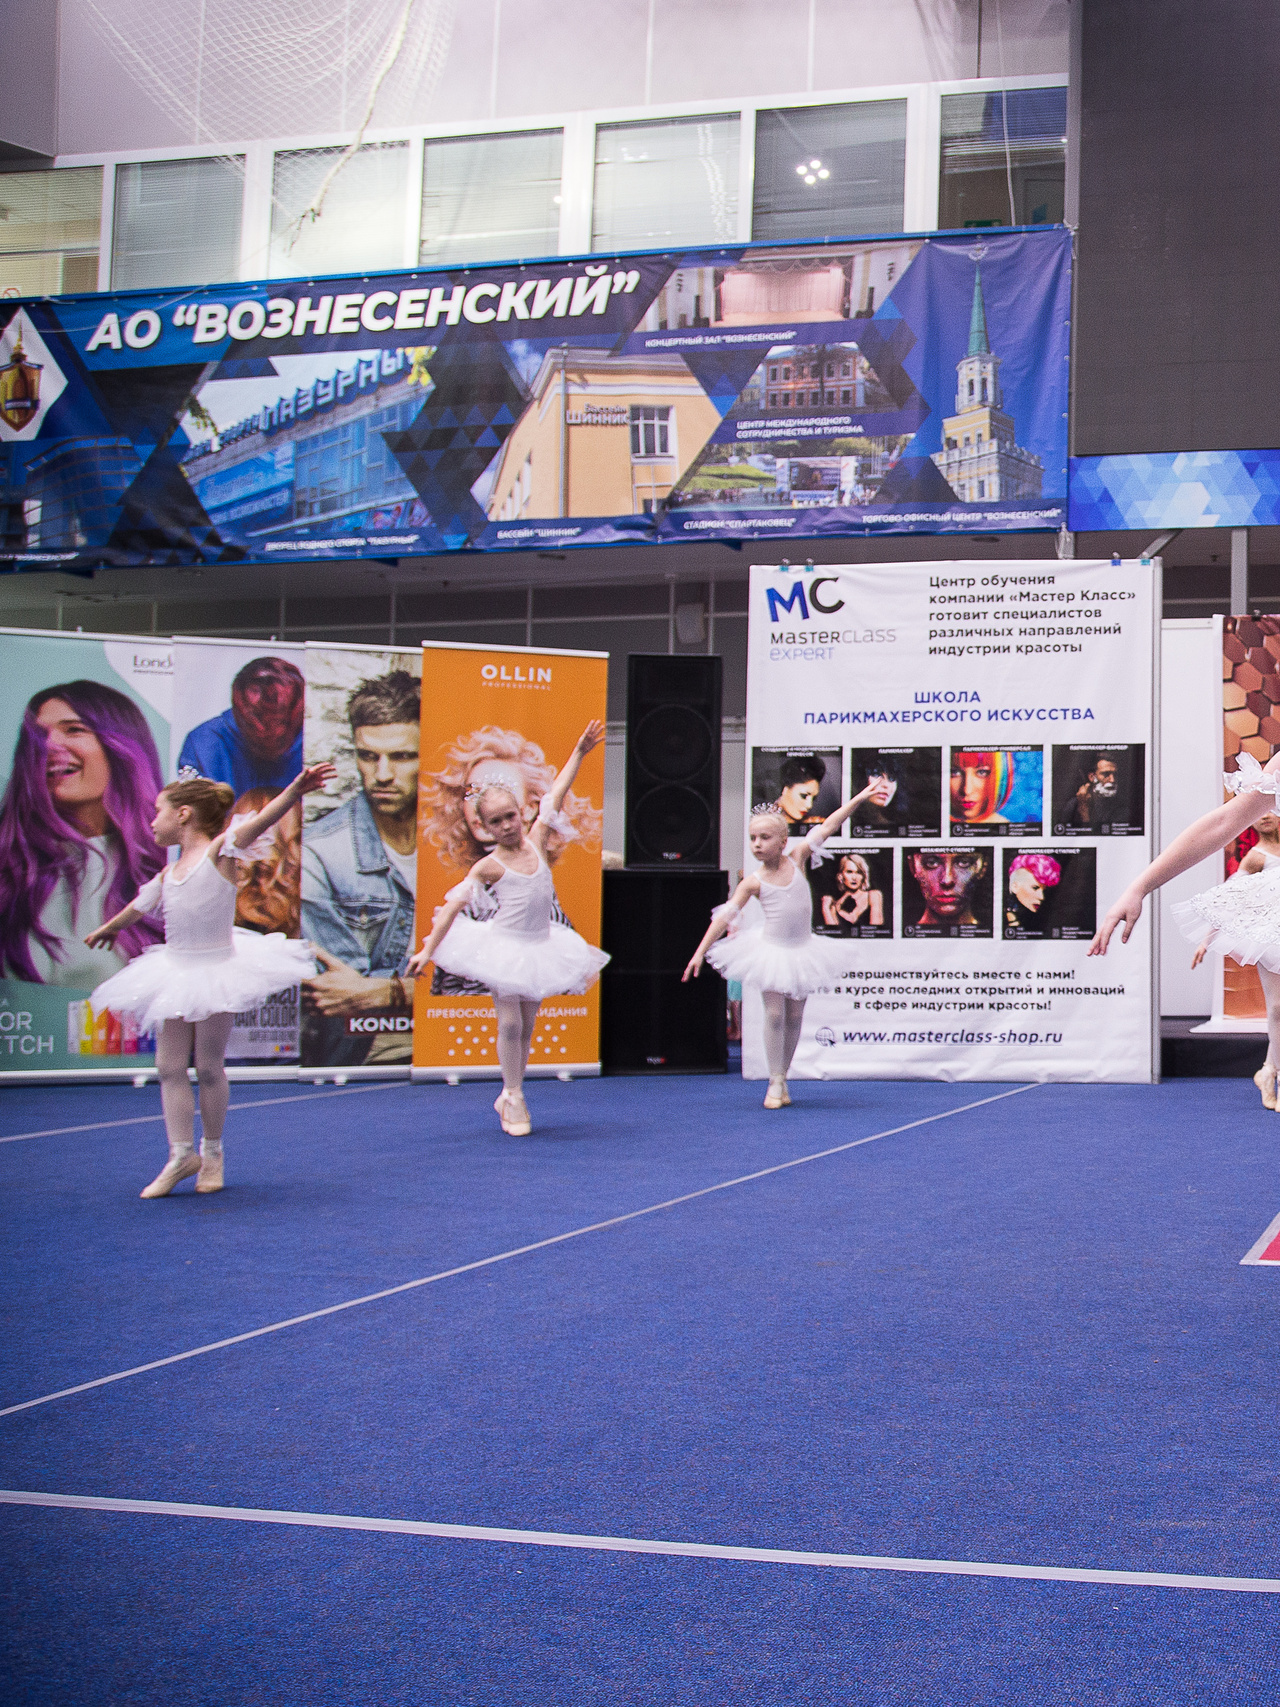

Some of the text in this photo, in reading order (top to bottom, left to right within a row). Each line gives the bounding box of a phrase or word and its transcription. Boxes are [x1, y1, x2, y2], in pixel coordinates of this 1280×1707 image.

[86, 310, 161, 352] АО
[645, 335, 702, 347] КОНЦЕРТНЫЙ
[736, 420, 765, 430] ЦЕНТР
[822, 425, 865, 434] ТУРИЗМА
[952, 513, 982, 522] ЦЕНТР
[929, 574, 1056, 588] Центр обучения
[929, 590, 1136, 604] компании «Мастер Класс»
[929, 608, 1102, 621] готовит специалистов
[928, 623, 1122, 640] различных направлений
[928, 643, 1083, 657] индустрии красоты
[481, 664, 552, 683] OLLIN
[914, 691, 981, 704] ШКОЛА
[803, 708, 1095, 724] ПАРИКМАХЕРСКОГО ИСКУССТВА
[841, 969, 1075, 981] овершенствуйтесь вместе с нами!
[835, 986, 841, 994] в
[846, 986, 885, 996] курсе
[889, 986, 960, 995] последних
[965, 985, 1033, 996] открытий
[1049, 985, 1125, 996] инноваций
[865, 1000, 907, 1011] сфере
[911, 1002, 984, 1012] индустрии
[988, 1001, 1052, 1011] красоты!
[426, 1007, 588, 1019] ПРЕВОСХОД ИДАНИЯ
[843, 1029, 1063, 1045] www.masterclass-shop.ru
[0, 1034, 54, 1054] TCH
